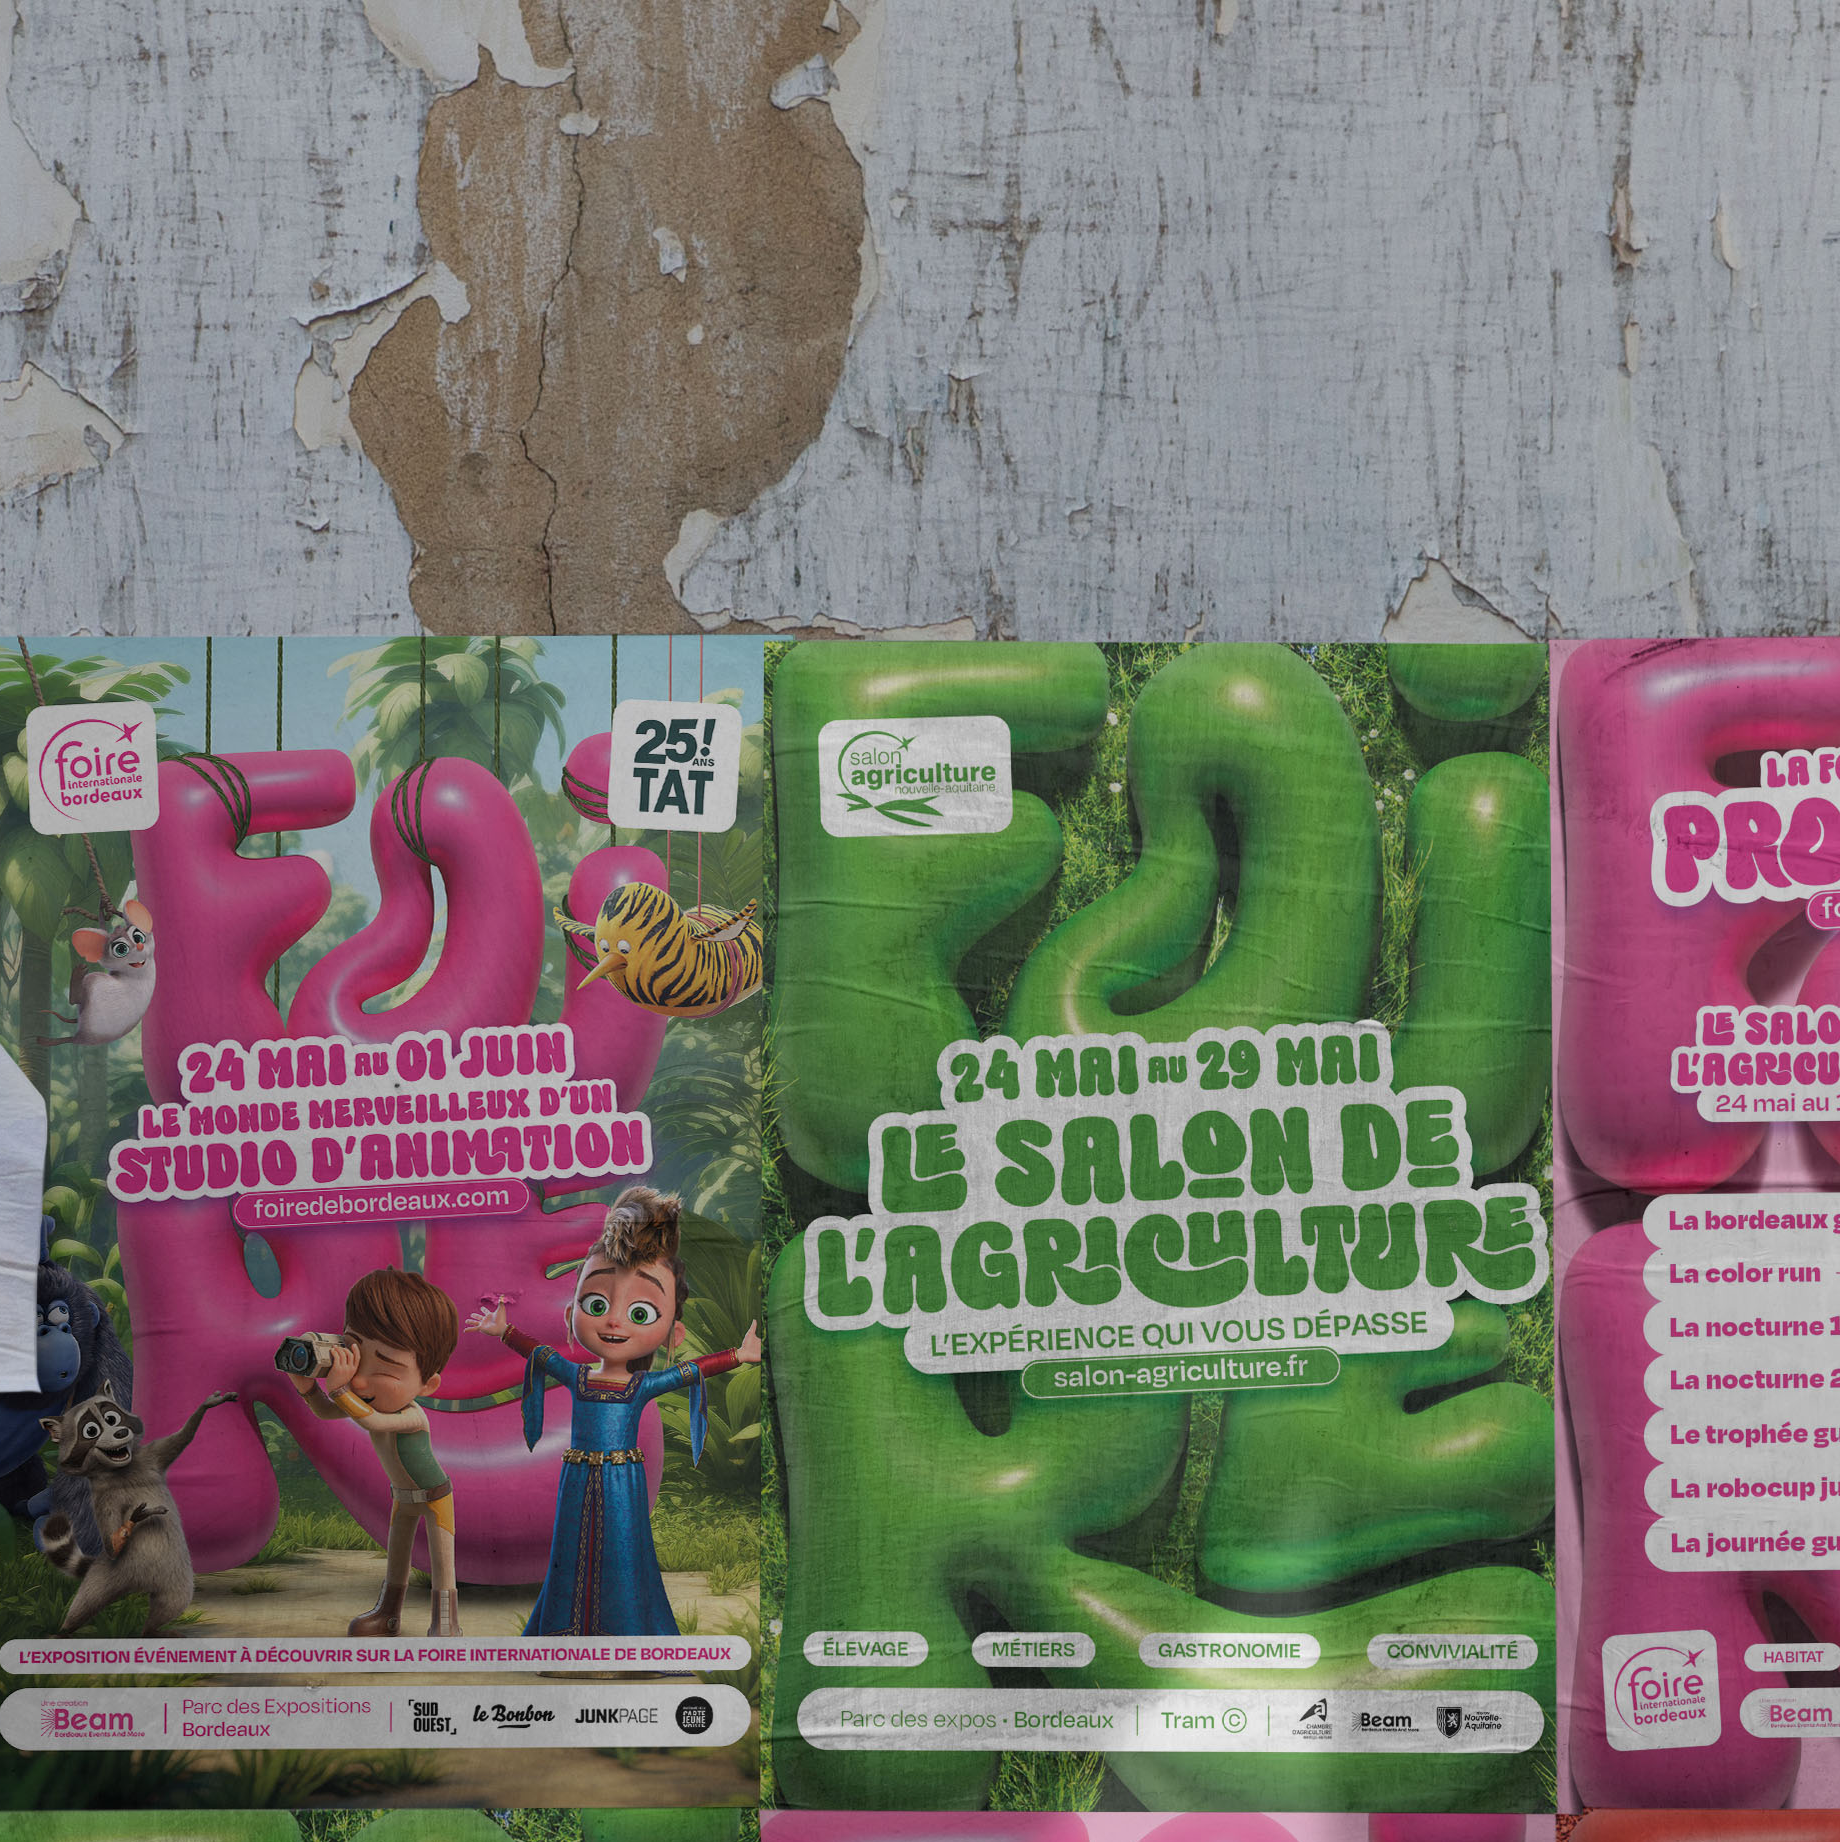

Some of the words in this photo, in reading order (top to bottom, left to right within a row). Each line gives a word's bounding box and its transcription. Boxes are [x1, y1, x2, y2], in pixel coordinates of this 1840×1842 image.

[55, 741, 140, 788] foire
[692, 758, 714, 766] ANS
[851, 748, 901, 768] salon
[68, 774, 142, 789] internationale
[852, 763, 995, 792] agriculture
[1767, 756, 1809, 787] LA
[61, 789, 142, 806] bordeaux
[633, 768, 713, 815] TAT
[895, 783, 995, 794] nouvelle-aquitaine
[1703, 1013, 1735, 1045] LE
[186, 1048, 245, 1093] 24
[258, 1044, 346, 1089] MAI
[355, 1052, 389, 1076] AU
[396, 1039, 446, 1081] 01
[460, 1032, 566, 1078] JUIN
[950, 1049, 1020, 1103] 24
[1036, 1045, 1139, 1098] MAI
[1148, 1056, 1187, 1083] AU
[1196, 1040, 1260, 1090] 29
[1276, 1033, 1380, 1086] MAI
[143, 1108, 181, 1138] LE
[190, 1102, 300, 1136] MONDE
[309, 1088, 530, 1129] MERVEILLEUX
[116, 1140, 297, 1194] STUDIO
[312, 1120, 644, 1183] D'ANIMATION
[882, 1124, 967, 1213] LE
[995, 1107, 1313, 1207] SALON
[1341, 1100, 1460, 1191] DE
[254, 1190, 509, 1218] foiredebordeaux.com
[1670, 1211, 1698, 1230] La
[1706, 1210, 1828, 1230] bordeaux
[1670, 1264, 1698, 1283] La
[1706, 1262, 1772, 1282] color
[1779, 1267, 1820, 1282] run
[1671, 1318, 1699, 1337] La
[1706, 1318, 1824, 1336] nocturne
[1055, 1354, 1308, 1387] salon-agriculture.fr
[1671, 1370, 1699, 1389] La
[1707, 1371, 1824, 1389] nocturne
[135, 1647, 237, 1663] ÉVÉNEMENT
[241, 1647, 251, 1662] À
[256, 1646, 352, 1662] DÉCOUVRIR
[357, 1649, 390, 1662] SUR
[395, 1649, 414, 1661] LA
[419, 1649, 466, 1661] FOIRE
[471, 1648, 610, 1661] INTERNATIONALE
[615, 1648, 636, 1660] DE
[641, 1648, 730, 1660] BORDEAUX
[824, 1637, 908, 1656] ÉLEVAGE
[993, 1639, 1075, 1656] MÉTIERS
[1158, 1643, 1300, 1658] GASTRONOMIE
[1387, 1641, 1517, 1659] CONVIVIALITÉ
[1464, 1722, 1502, 1731] Aquitaine
